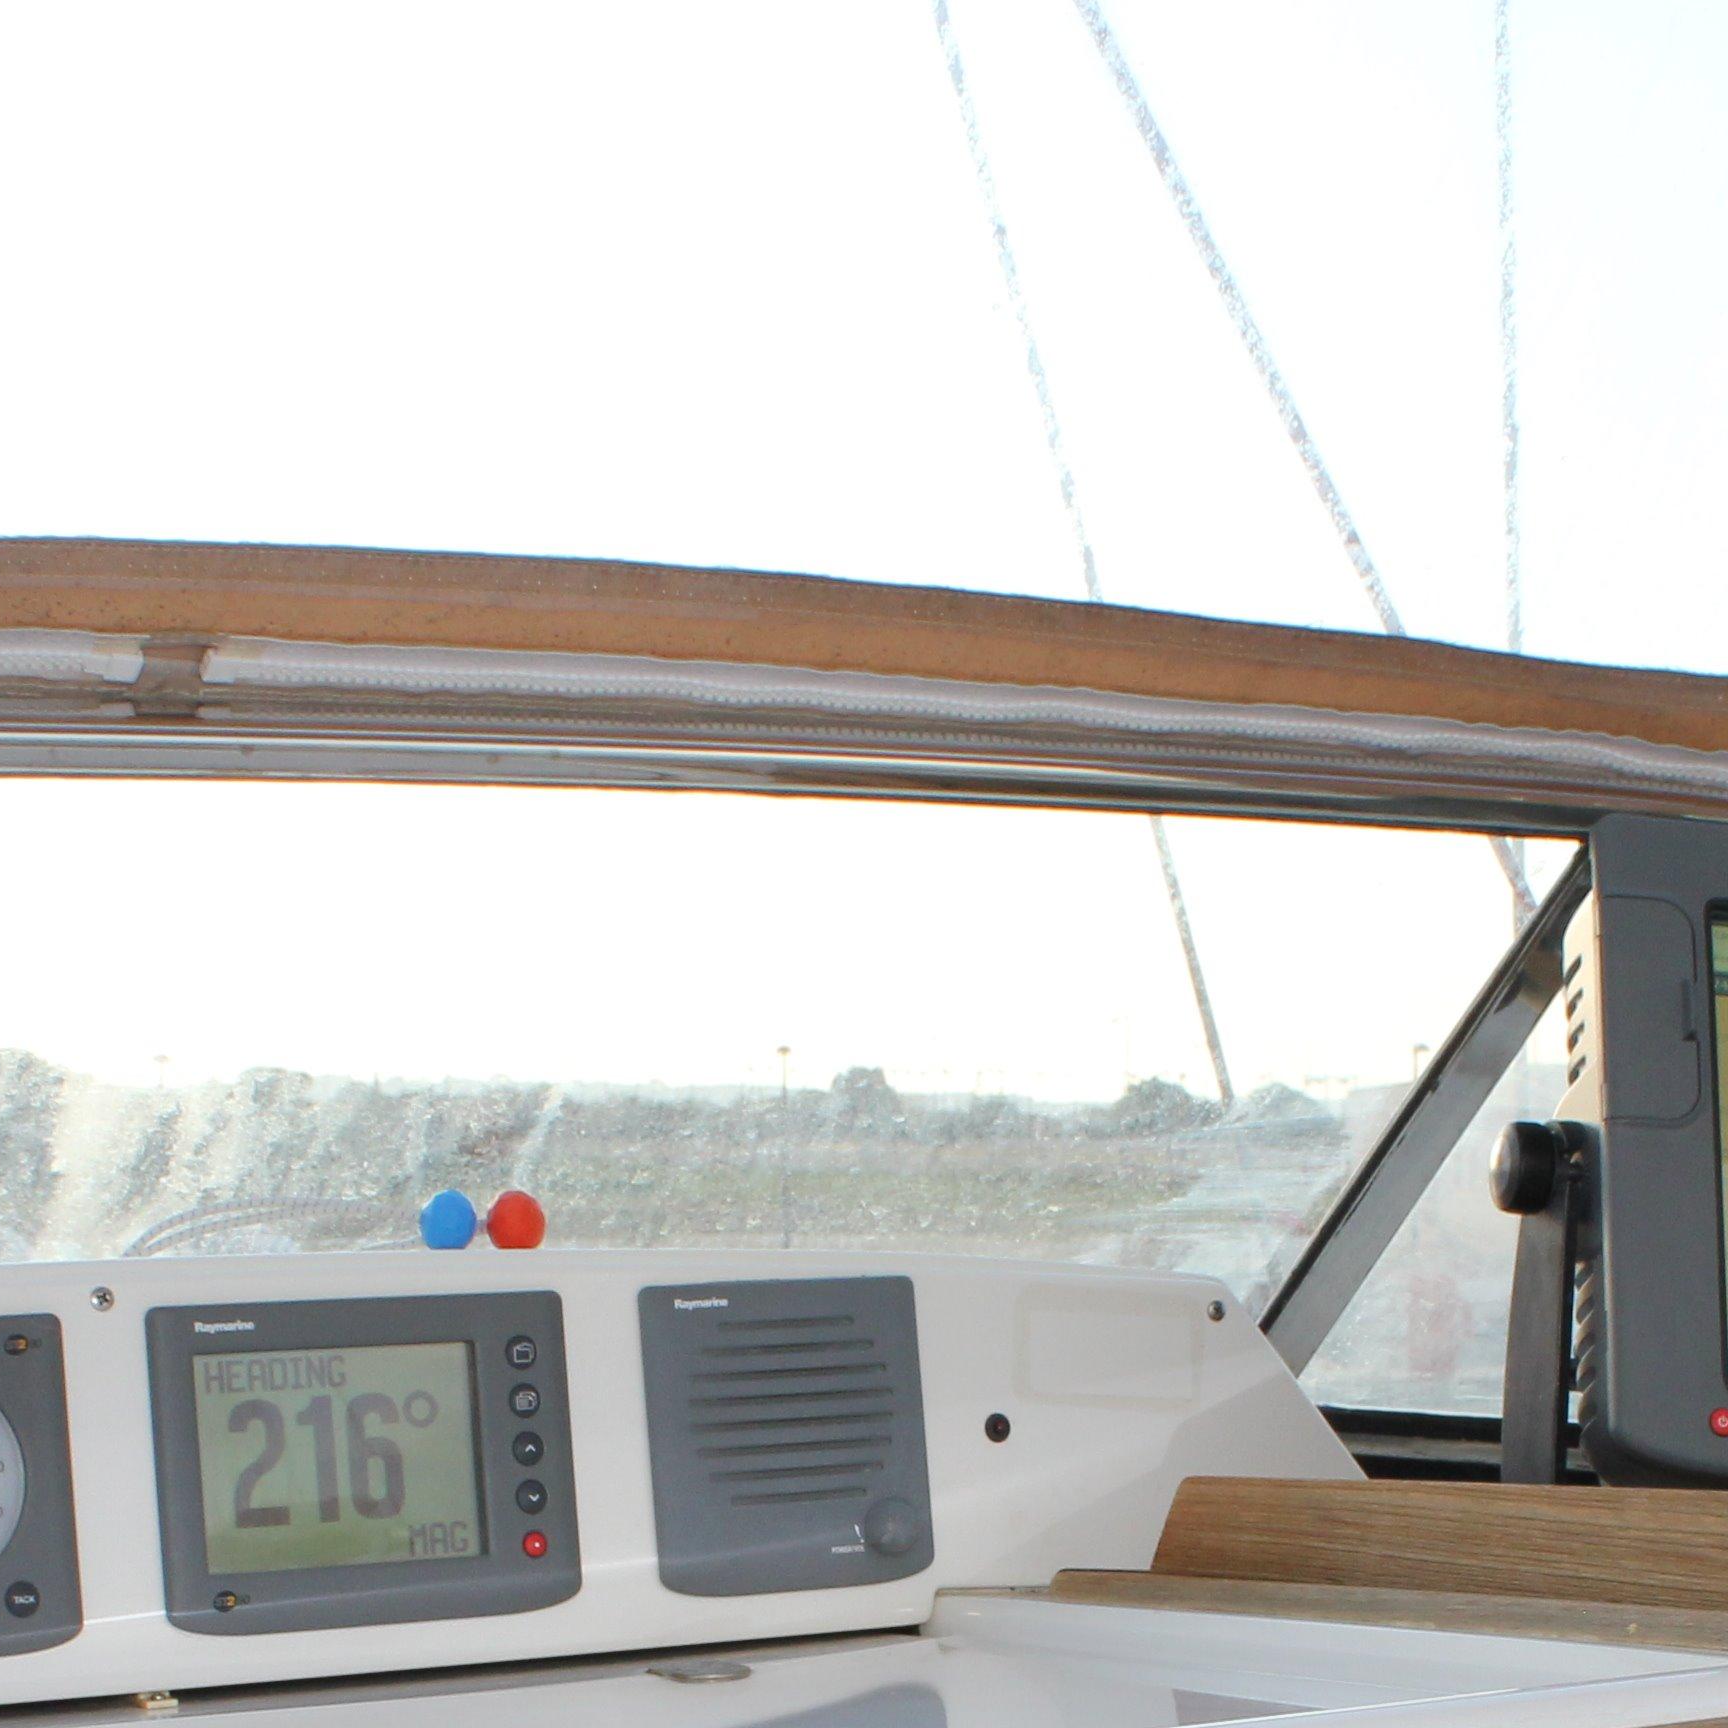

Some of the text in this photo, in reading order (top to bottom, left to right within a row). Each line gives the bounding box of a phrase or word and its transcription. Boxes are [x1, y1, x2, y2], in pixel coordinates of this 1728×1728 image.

[193, 1319, 256, 1334] Raymarine
[203, 1354, 348, 1394] HEADING
[408, 1522, 470, 1557] MAG
[14, 1594, 36, 1605] TACK
